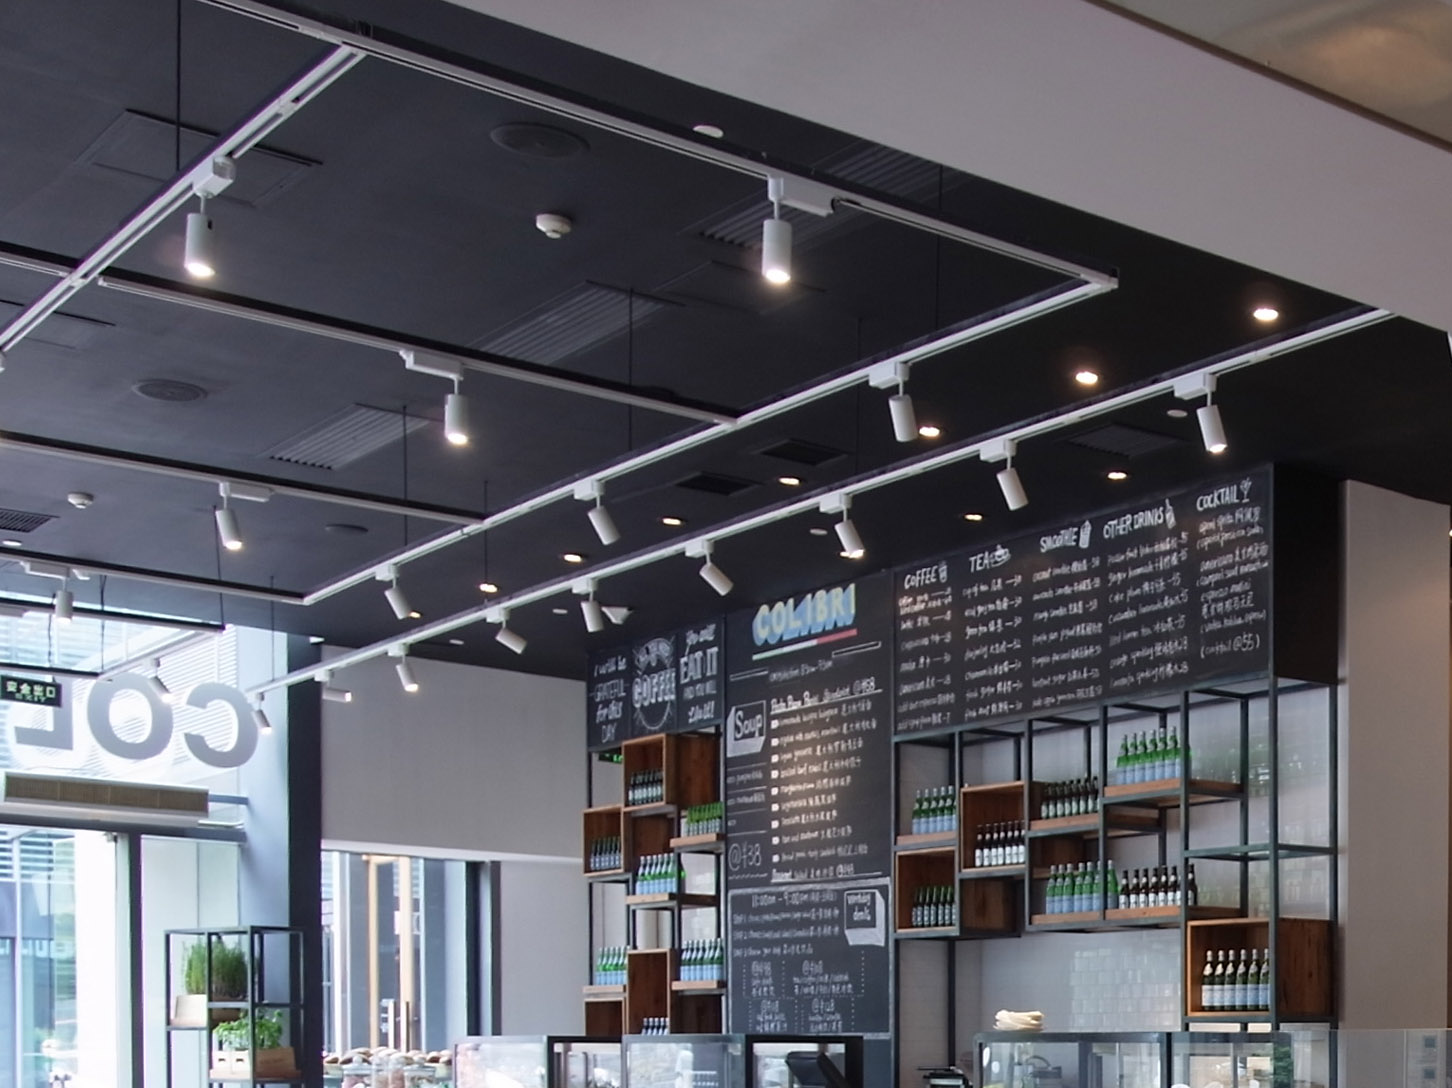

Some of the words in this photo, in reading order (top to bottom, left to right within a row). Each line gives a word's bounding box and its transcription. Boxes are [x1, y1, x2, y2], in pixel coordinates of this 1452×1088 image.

[1196, 484, 1240, 512] COCKTAIL
[1103, 513, 1132, 539] OTHER
[1133, 506, 1164, 530] DRINKS
[969, 551, 990, 573] TEA
[904, 565, 938, 589] COFFEE
[752, 582, 856, 647] COLIBRI
[680, 650, 704, 684] EAT
[706, 646, 719, 677] IT
[6, 681, 56, 698] 安全出口
[632, 667, 676, 708] COFFEE
[735, 710, 763, 739] Soup
